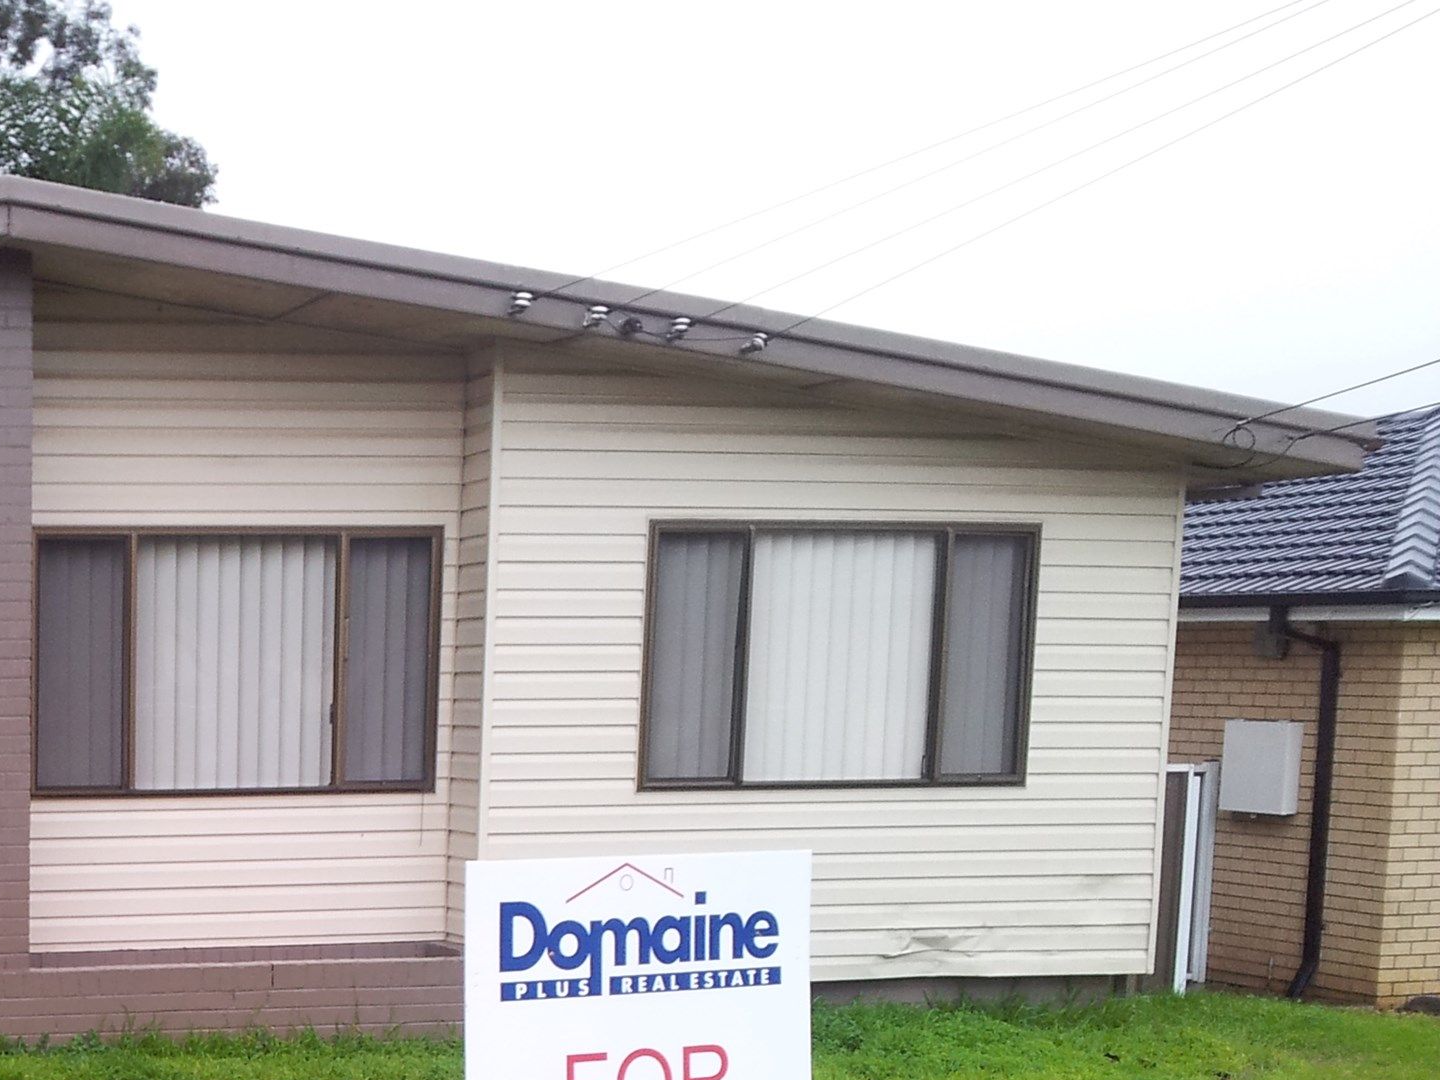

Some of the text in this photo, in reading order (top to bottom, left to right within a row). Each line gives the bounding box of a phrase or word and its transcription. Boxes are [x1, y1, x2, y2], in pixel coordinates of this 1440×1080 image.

[499, 891, 779, 995] Domaine
[514, 968, 771, 1000] PLUS REAL ESTATE
